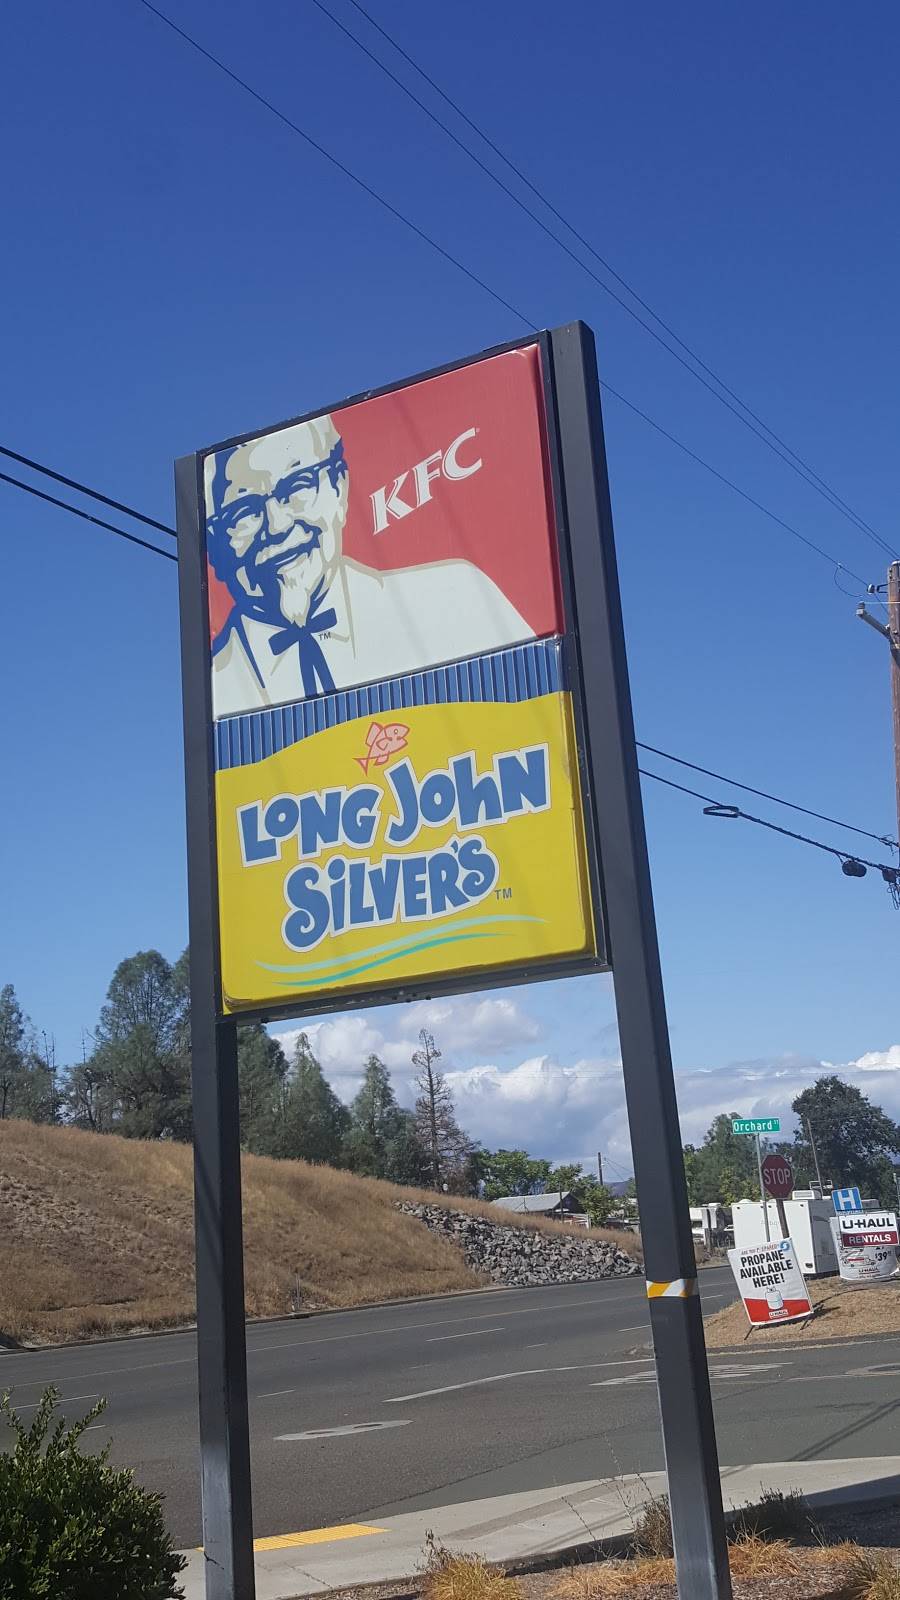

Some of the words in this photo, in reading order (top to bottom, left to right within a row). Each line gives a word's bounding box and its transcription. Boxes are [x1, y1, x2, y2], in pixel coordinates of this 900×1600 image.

[369, 427, 482, 535] KFC
[318, 631, 331, 641] TM
[238, 786, 382, 865] LONG
[495, 888, 512, 899] TM
[733, 1120, 772, 1132] Orchard
[763, 1168, 790, 1185] STOP
[837, 1188, 858, 1209] H
[842, 1218, 894, 1229] U-HAUL
[849, 1234, 891, 1244] RENTALS
[740, 1250, 785, 1267] PROPANE
[740, 1260, 793, 1279] AVAILABLE
[752, 1273, 785, 1288] HERE!
